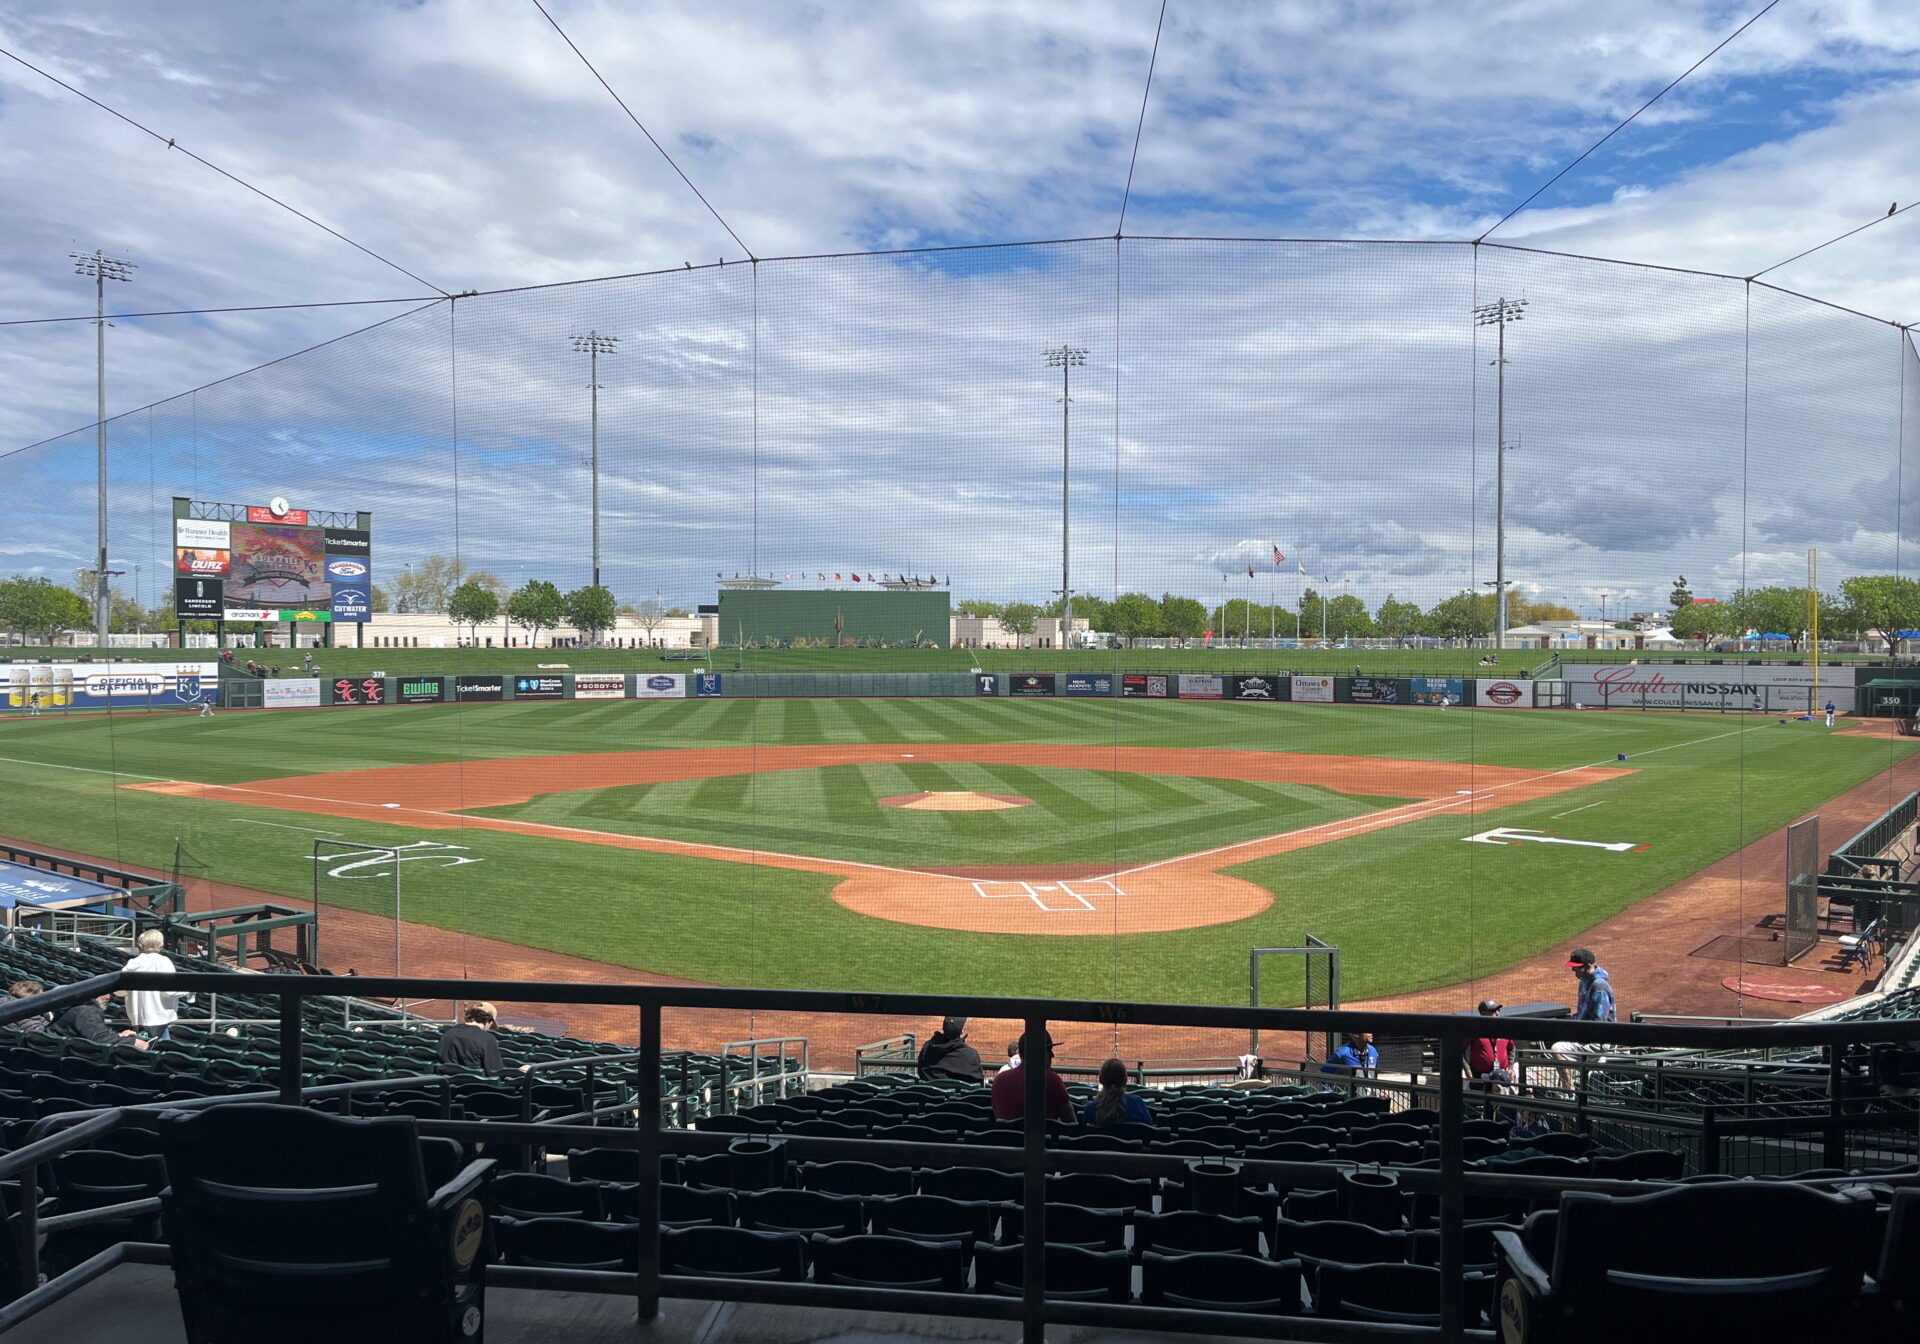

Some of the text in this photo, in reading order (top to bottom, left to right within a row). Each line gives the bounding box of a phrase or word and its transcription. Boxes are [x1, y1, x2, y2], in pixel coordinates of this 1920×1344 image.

[325, 538, 368, 547] TicketSmarter
[334, 605, 368, 613] CUTWATER
[231, 611, 260, 619] aramark
[980, 676, 994, 691] T
[1593, 667, 1681, 697] Coulter
[1687, 683, 1758, 695] NISSAN
[91, 682, 159, 692] CRAFT BEER
[1632, 698, 1733, 707] WWW.COULTENISSAN.CM
